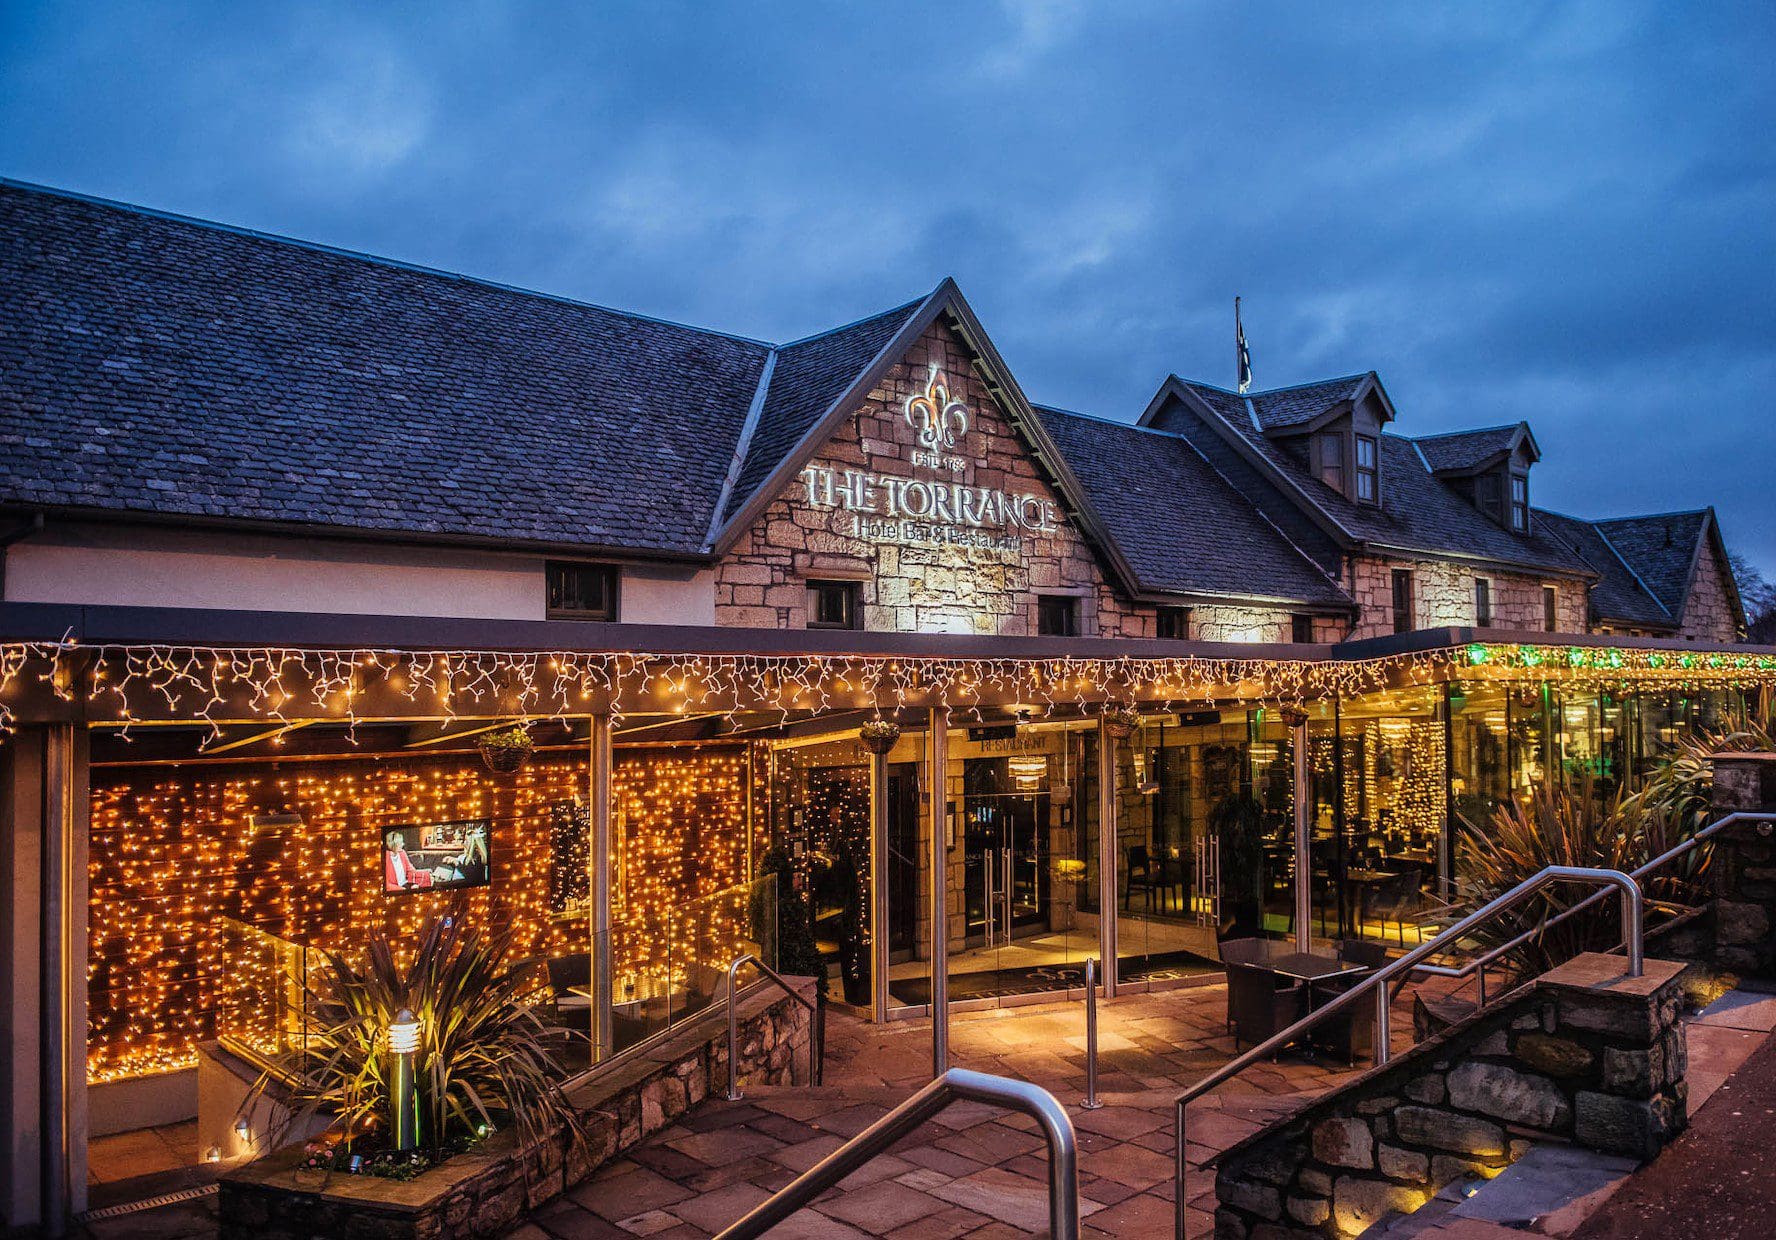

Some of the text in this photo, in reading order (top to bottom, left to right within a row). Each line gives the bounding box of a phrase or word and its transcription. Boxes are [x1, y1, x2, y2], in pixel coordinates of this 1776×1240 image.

[801, 465, 1057, 532] THE TORRANCE
[853, 515, 1021, 550] Hotel Bar & Restaurant
